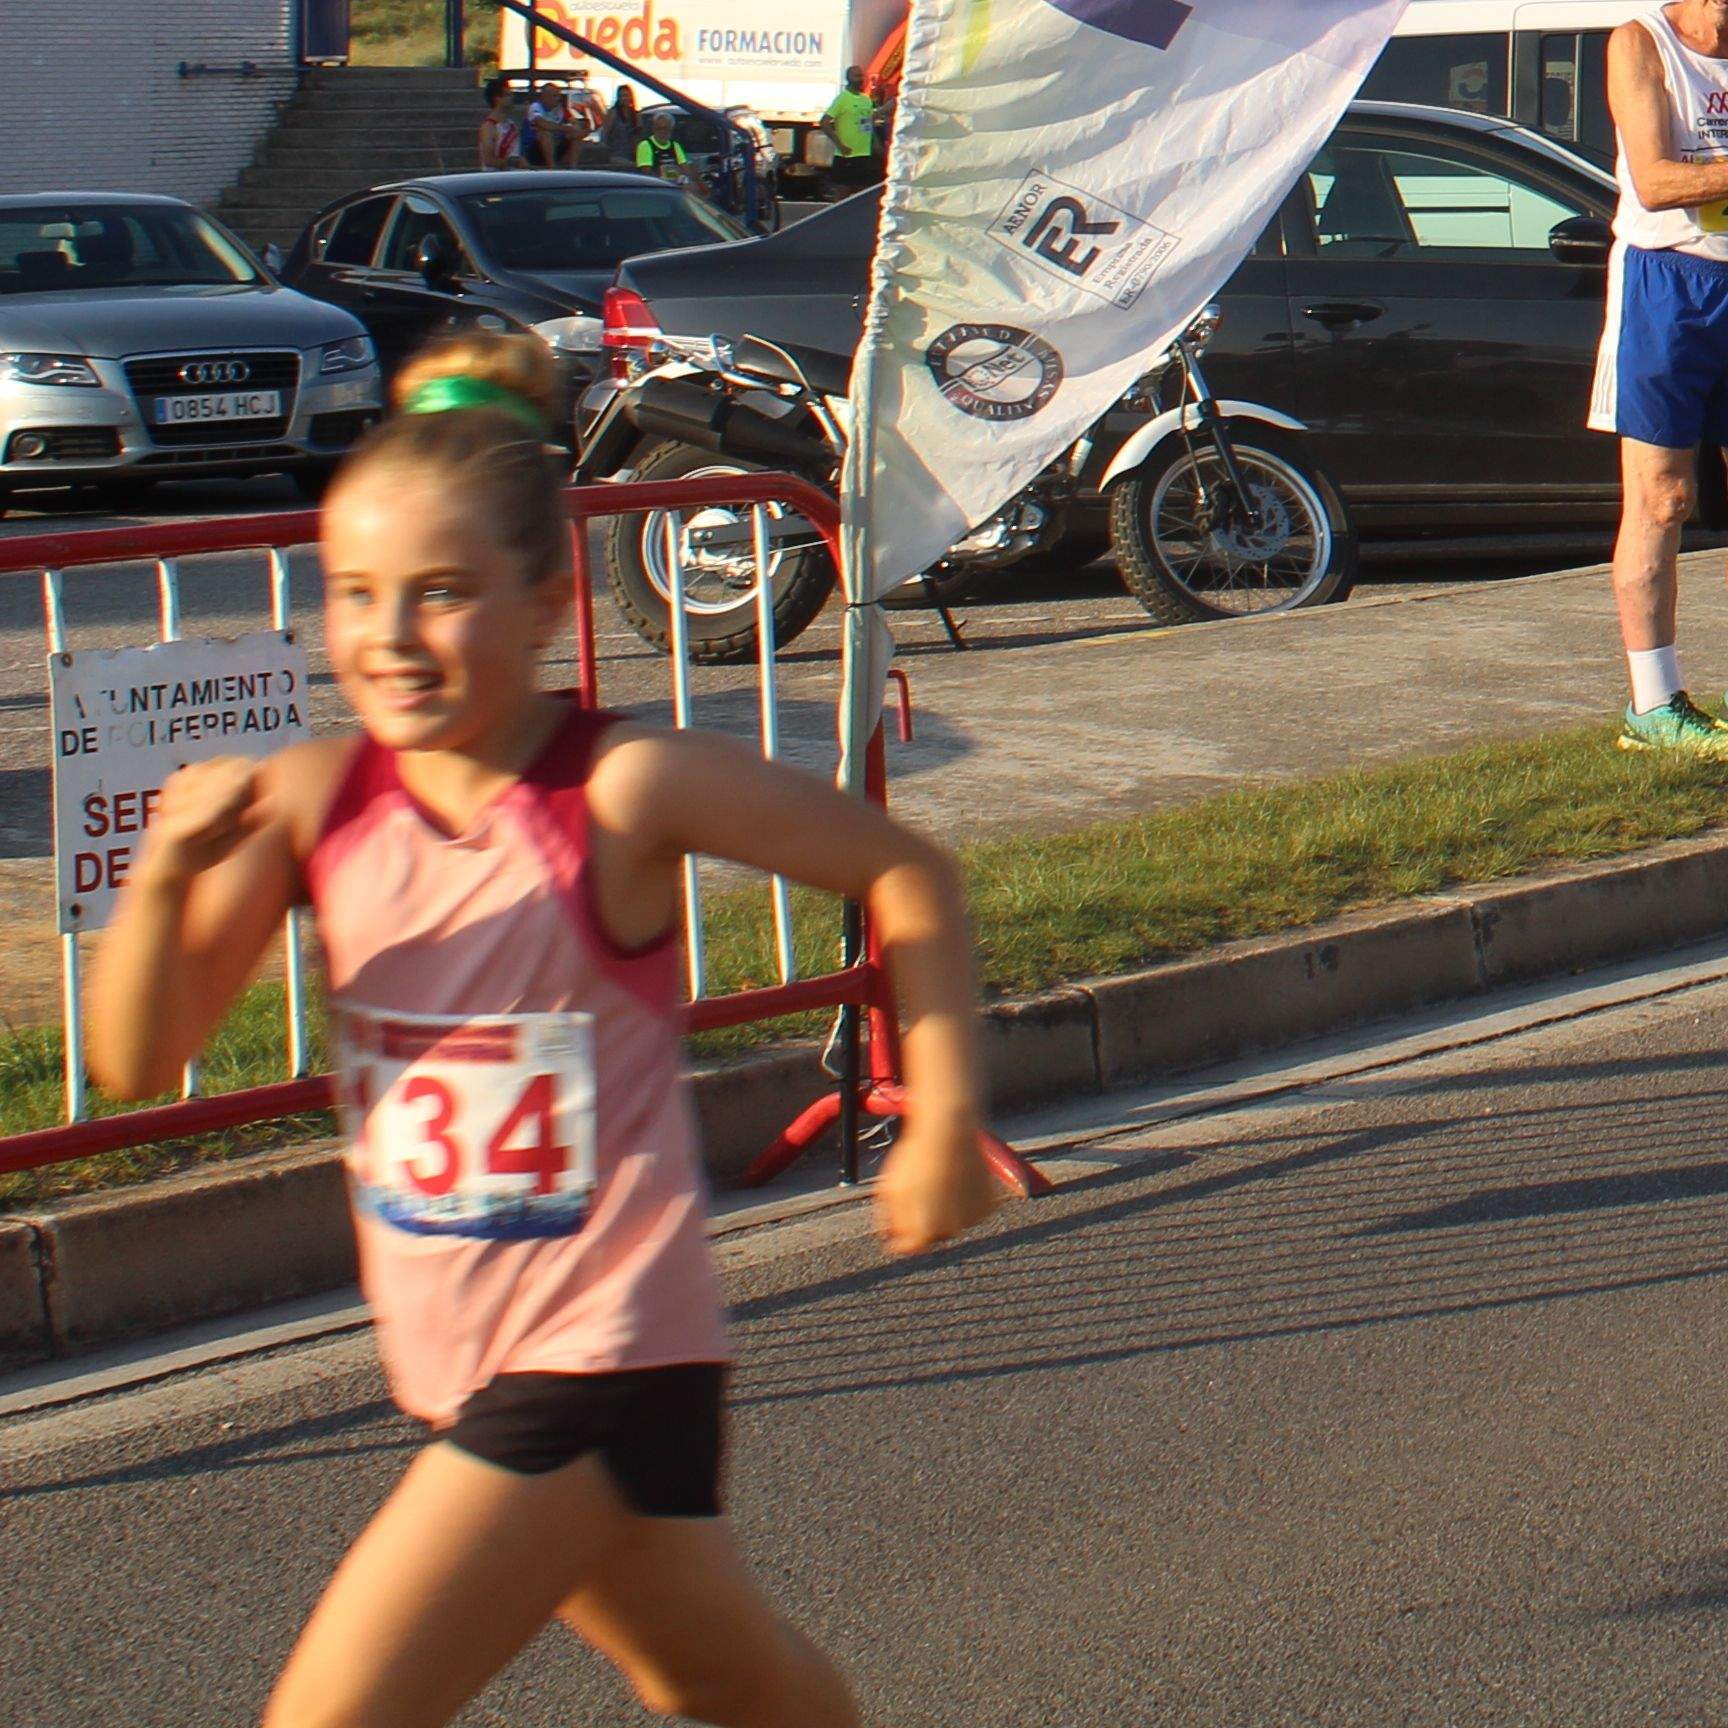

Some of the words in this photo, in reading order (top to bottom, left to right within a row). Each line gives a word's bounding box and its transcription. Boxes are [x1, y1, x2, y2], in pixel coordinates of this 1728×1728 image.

[699, 29, 823, 54] FORMACION
[1003, 184, 1047, 236] AENOR
[1104, 237, 1152, 290] Registrada
[171, 399, 228, 419] 0854
[234, 394, 276, 416] HCJ
[61, 726, 98, 757] DE
[403, 1072, 573, 1197] 34
